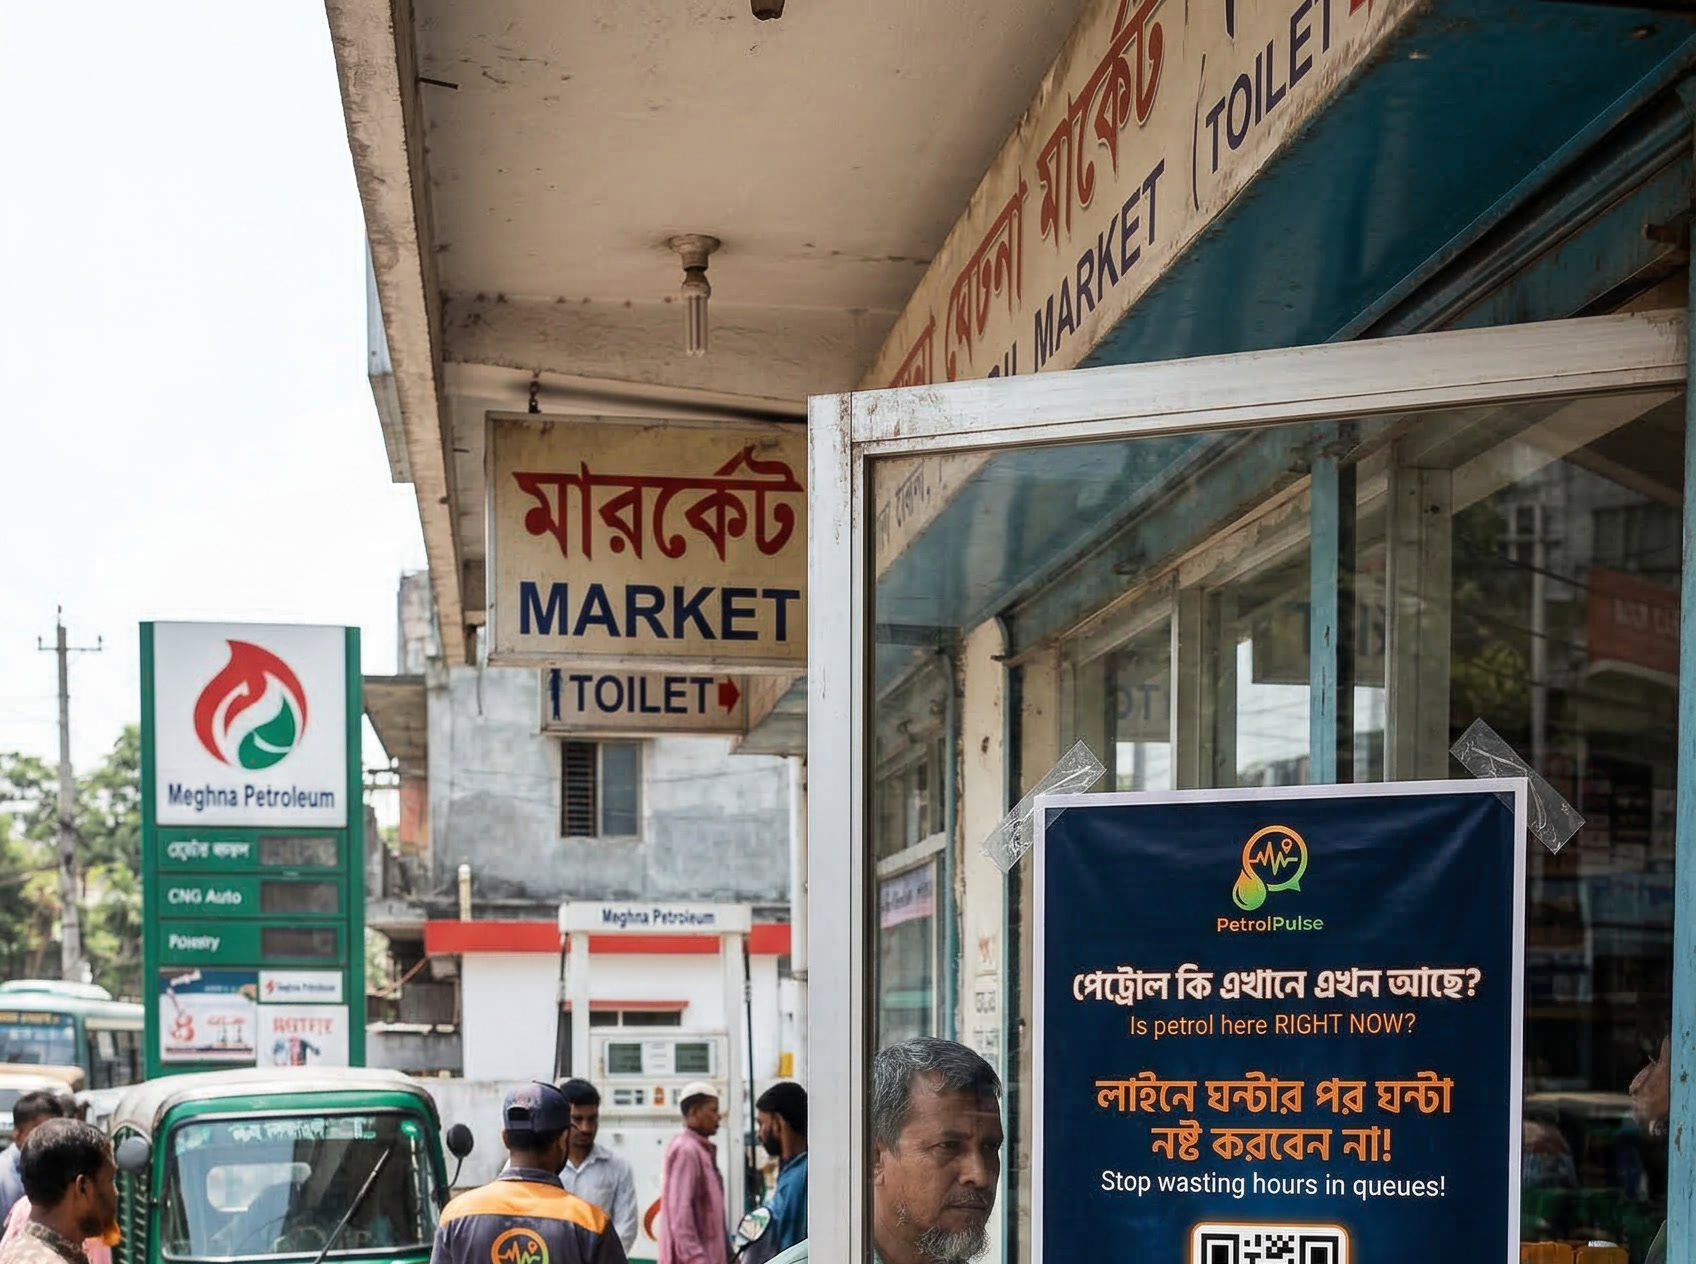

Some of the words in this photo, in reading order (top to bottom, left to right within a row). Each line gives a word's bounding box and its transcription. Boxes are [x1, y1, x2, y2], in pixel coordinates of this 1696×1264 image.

[1034, 158, 1165, 373] MARKET
[519, 581, 801, 641] MARKET
[570, 674, 714, 714] TOILET
[168, 783, 238, 811] Meghna
[244, 785, 335, 808] Petroleum
[168, 888, 202, 904] CNG
[1216, 916, 1324, 932] PetrolPulse
[1073, 965, 1170, 1006] পেট্রোল
[1175, 963, 1213, 999] কি
[1220, 969, 1307, 1000] এখানে
[1314, 967, 1382, 999] এখন
[1387, 966, 1481, 999] আছে?
[1131, 1015, 1147, 1035] Is
[1154, 1014, 1213, 1039] petrol
[1221, 1014, 1267, 1035] here
[1275, 1013, 1343, 1034] RIGHT
[1350, 1012, 1416, 1034] NOW?
[1095, 1071, 1197, 1113] লাইনে
[1316, 1077, 1367, 1115] পর
[1151, 1119, 1202, 1161] নষ্ট
[1210, 1128, 1333, 1162] করবেন
[1342, 1125, 1391, 1162] না!
[1101, 1170, 1151, 1197] Stop
[1158, 1171, 1245, 1198] wasting
[1253, 1171, 1318, 1195] hours
[1325, 1173, 1345, 1195] in
[1353, 1175, 1446, 1200] queues!
